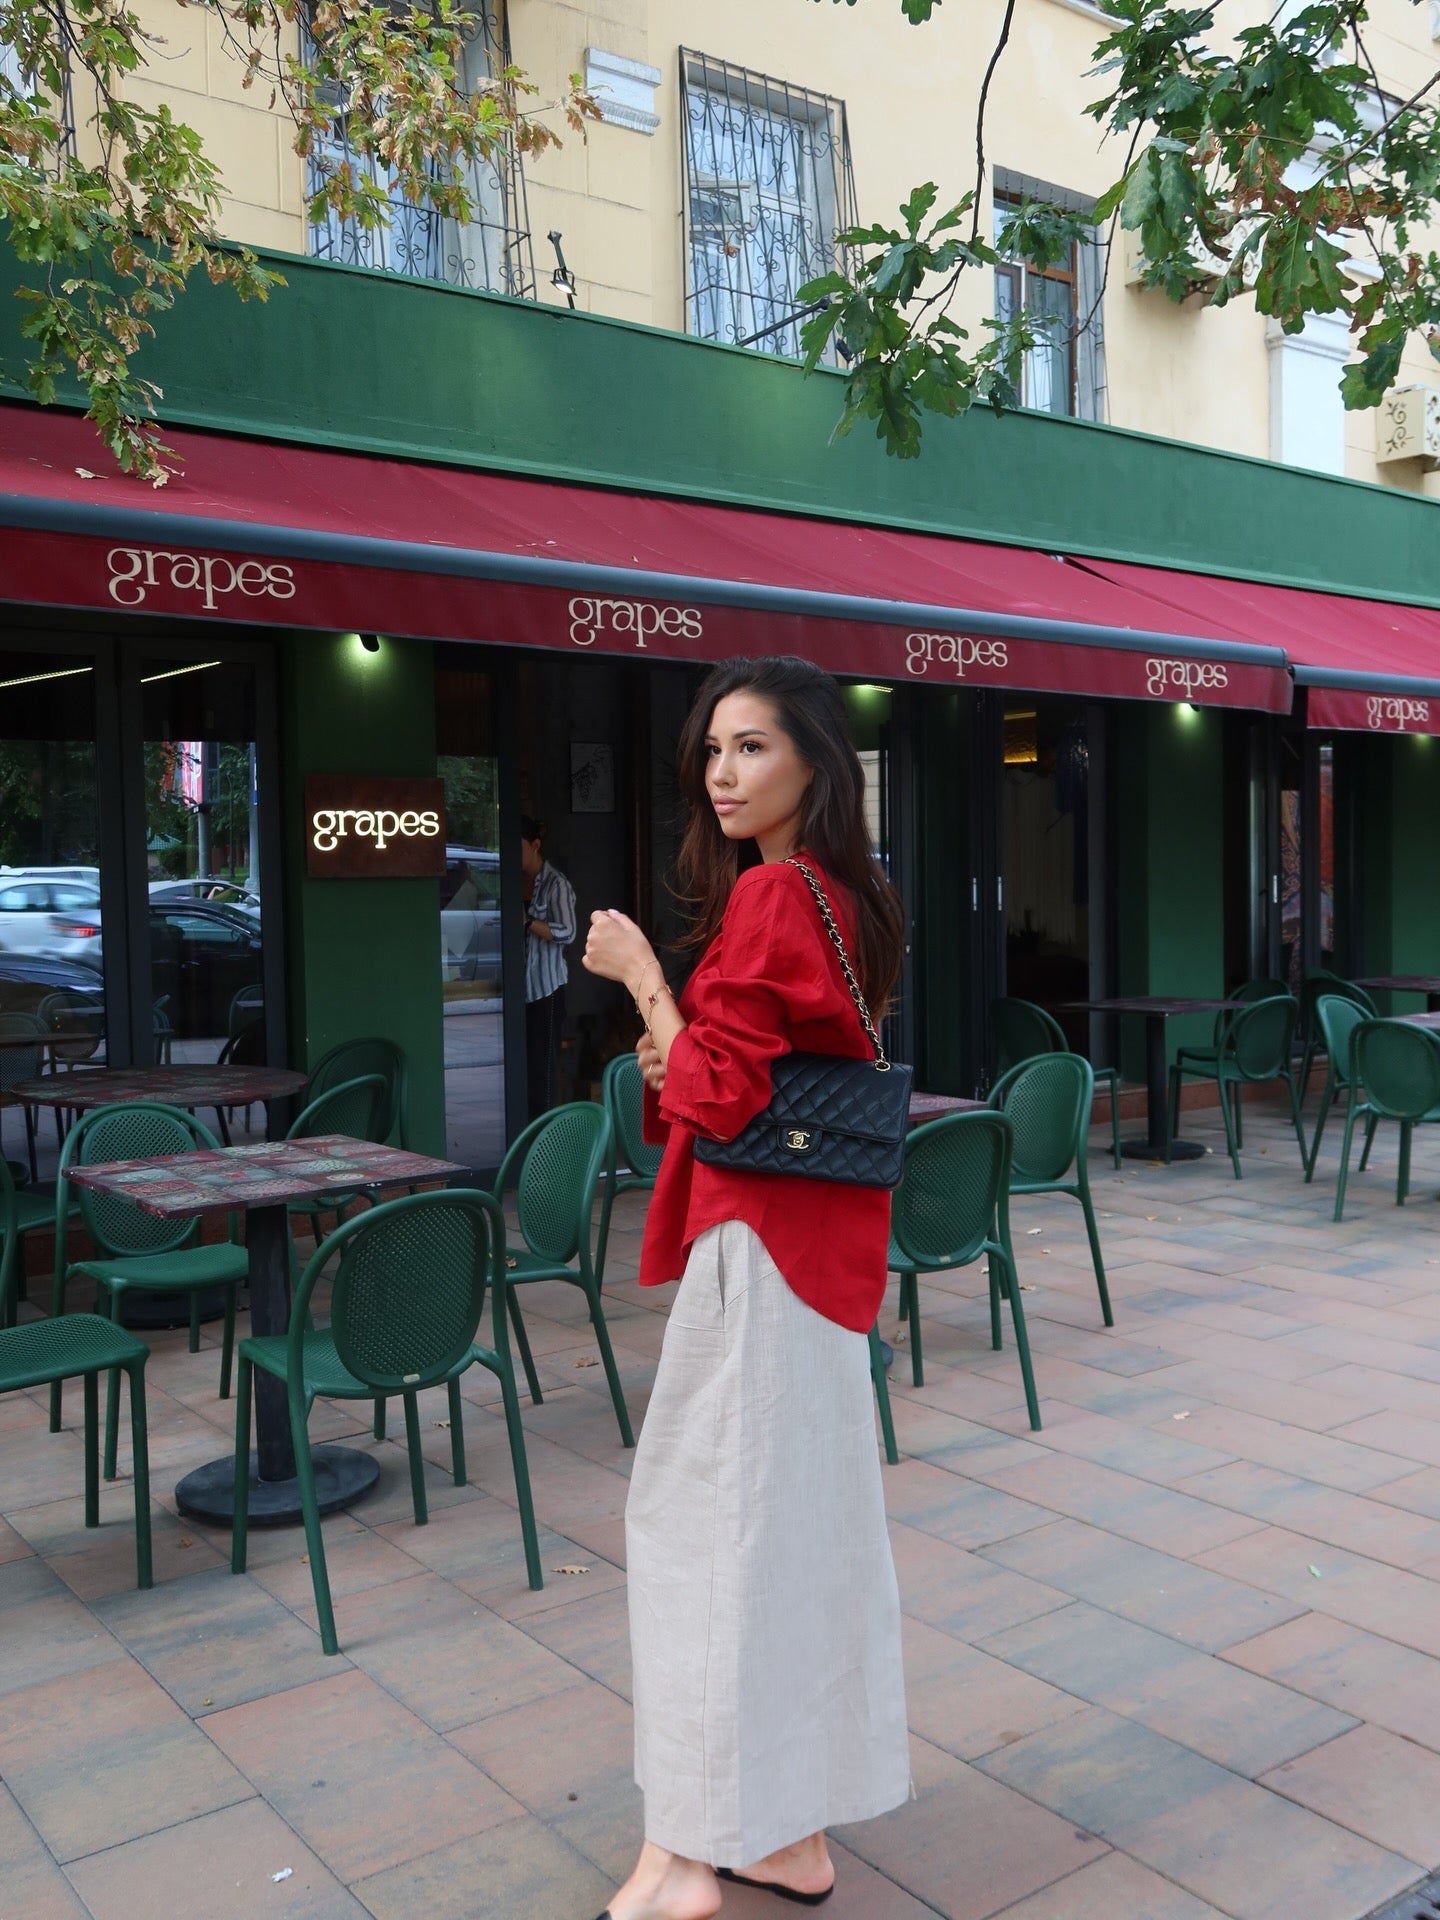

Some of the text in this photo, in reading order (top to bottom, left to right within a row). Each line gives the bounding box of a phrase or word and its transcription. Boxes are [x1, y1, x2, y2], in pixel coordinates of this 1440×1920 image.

[106, 547, 296, 610] grapes
[568, 597, 703, 648] grapes
[905, 633, 1008, 677] grapes
[1145, 658, 1228, 697] grapes
[1365, 695, 1430, 733] grapes
[312, 808, 440, 852] grapes
